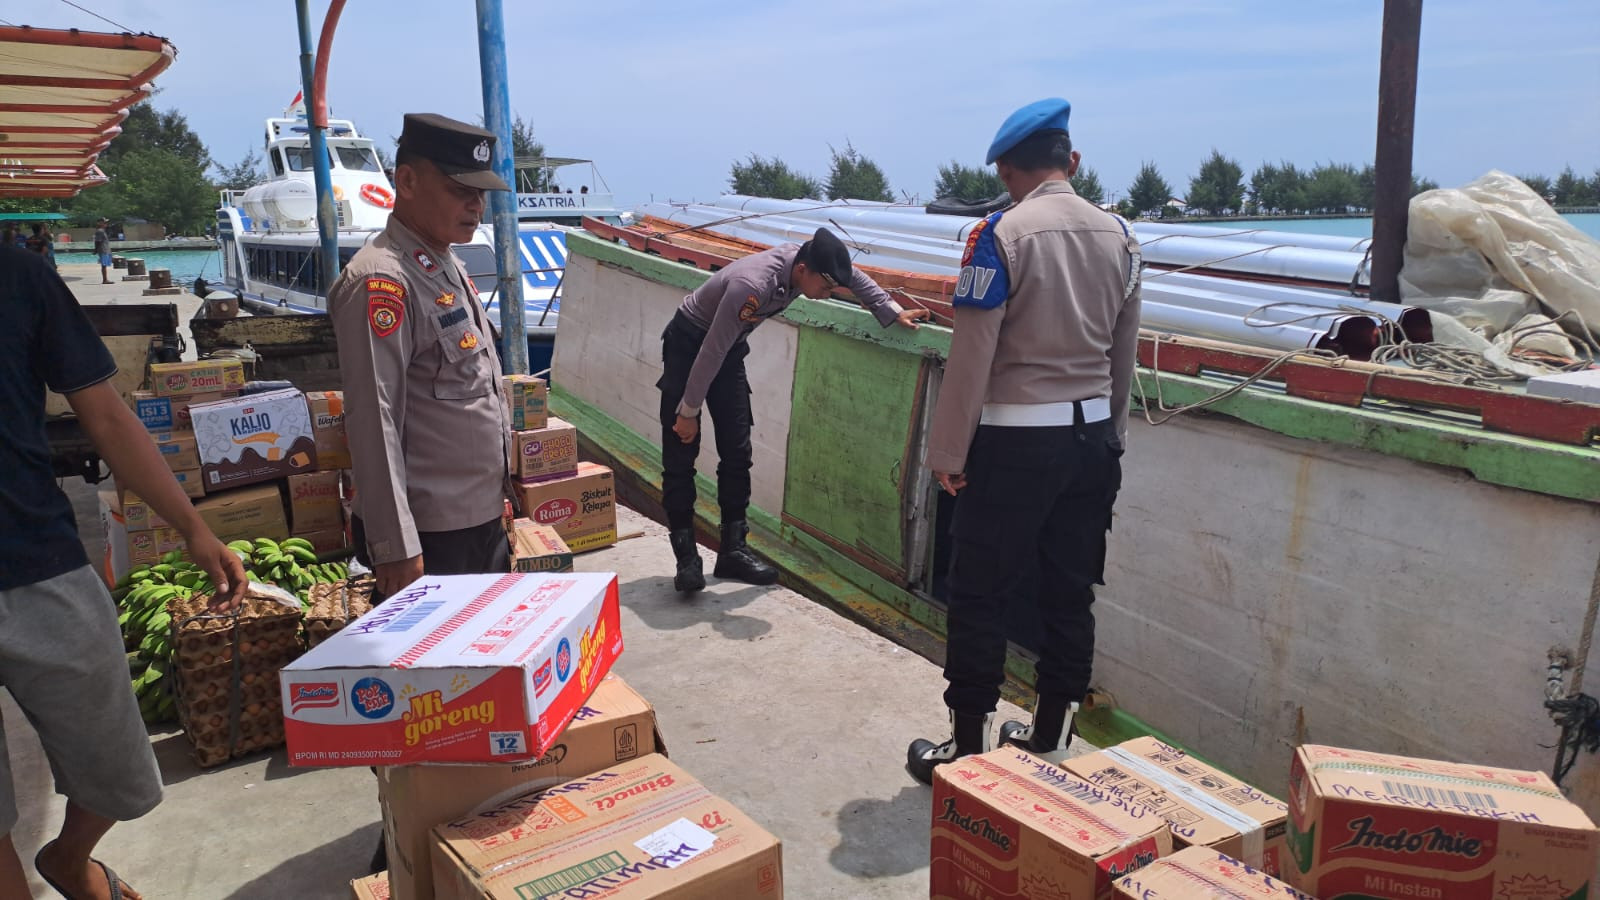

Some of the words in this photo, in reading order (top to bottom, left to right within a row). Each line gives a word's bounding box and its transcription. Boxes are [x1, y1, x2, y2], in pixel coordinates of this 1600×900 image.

[230, 413, 271, 436] KALIO
[581, 487, 612, 502] Biskuit
[539, 506, 571, 521] Roma
[582, 501, 611, 514] Kelapa
[355, 683, 381, 703] POP
[401, 690, 444, 722] Mi
[404, 699, 496, 747] goreng
[495, 737, 519, 749] 12
[295, 751, 318, 760] BPOM
[319, 751, 327, 759] RI
[328, 751, 340, 759] MD
[591, 772, 676, 813] Bimoli
[1364, 874, 1385, 890] Mi
[1389, 878, 1442, 899] Instan
